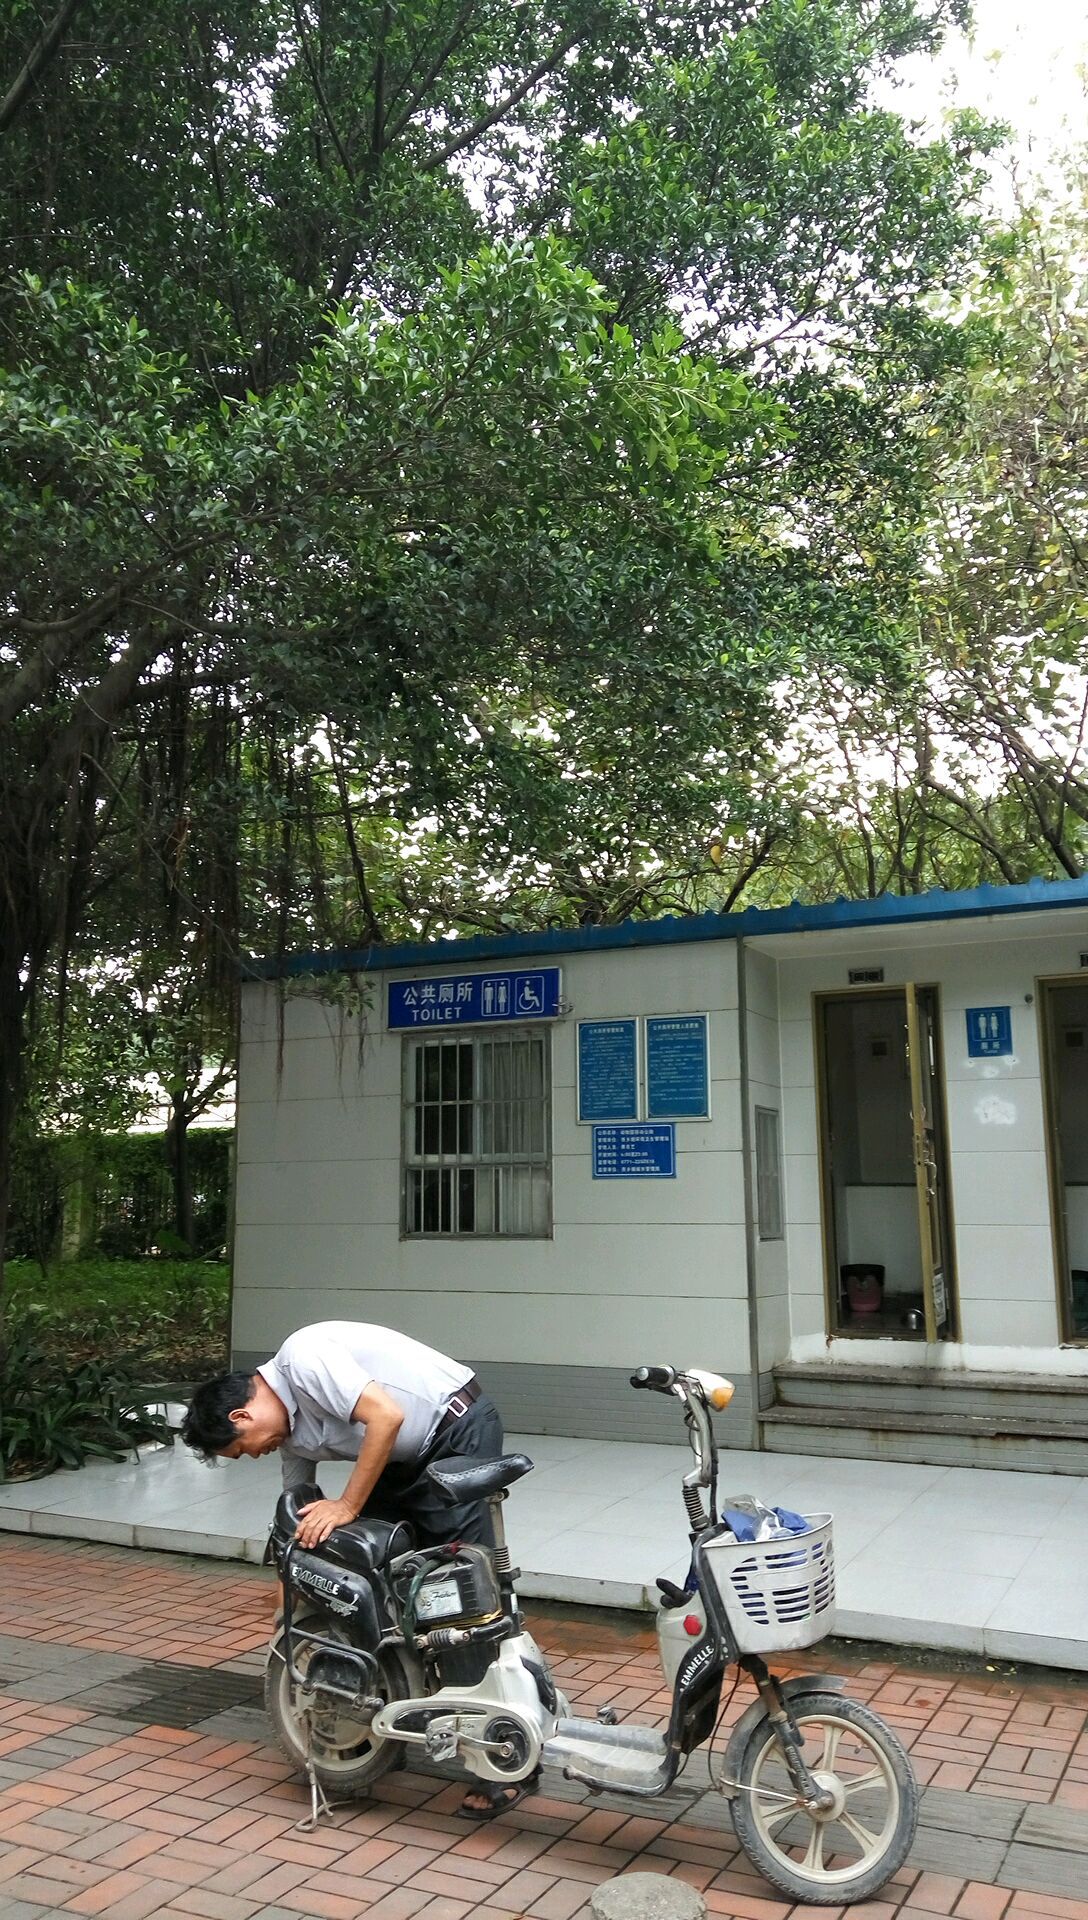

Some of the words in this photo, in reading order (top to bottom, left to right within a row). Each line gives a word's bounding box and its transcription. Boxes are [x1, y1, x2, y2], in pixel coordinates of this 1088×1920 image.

[403, 982, 473, 1006] 公共厕所
[412, 1007, 462, 1022] TOILET
[292, 1566, 340, 1595] EMMELLE
[681, 1645, 714, 1686] EMMELLE
